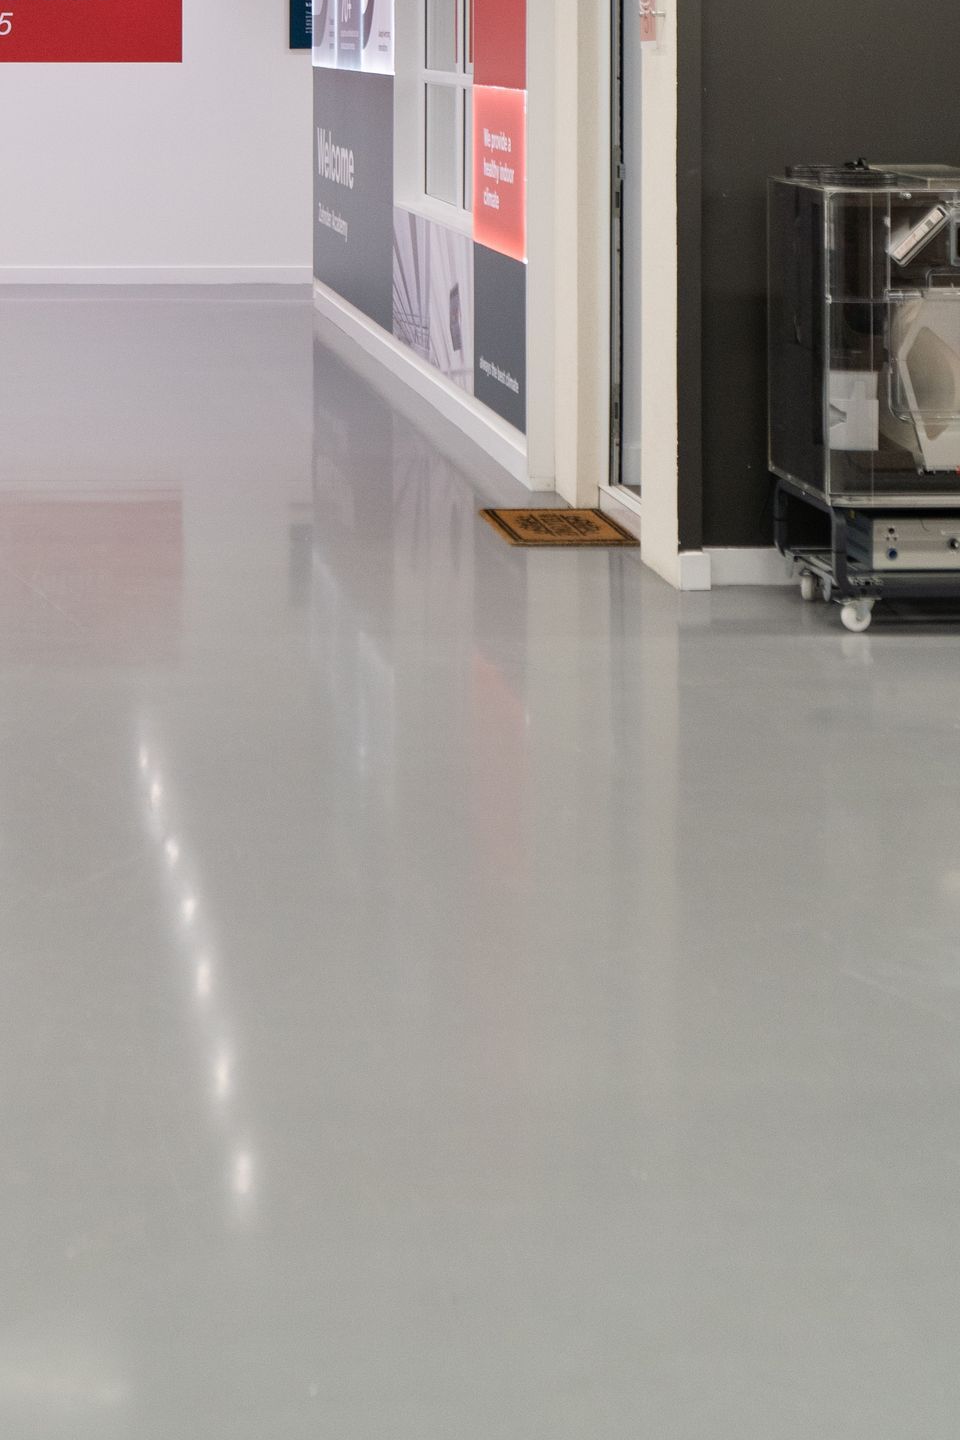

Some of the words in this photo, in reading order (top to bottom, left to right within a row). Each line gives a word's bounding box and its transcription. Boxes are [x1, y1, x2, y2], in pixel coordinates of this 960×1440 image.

[483, 128, 491, 148] We
[491, 132, 507, 153] provide
[317, 127, 355, 190] Welcome
[483, 157, 499, 184] healthy
[499, 162, 515, 184] indoor
[483, 187, 500, 210] climate
